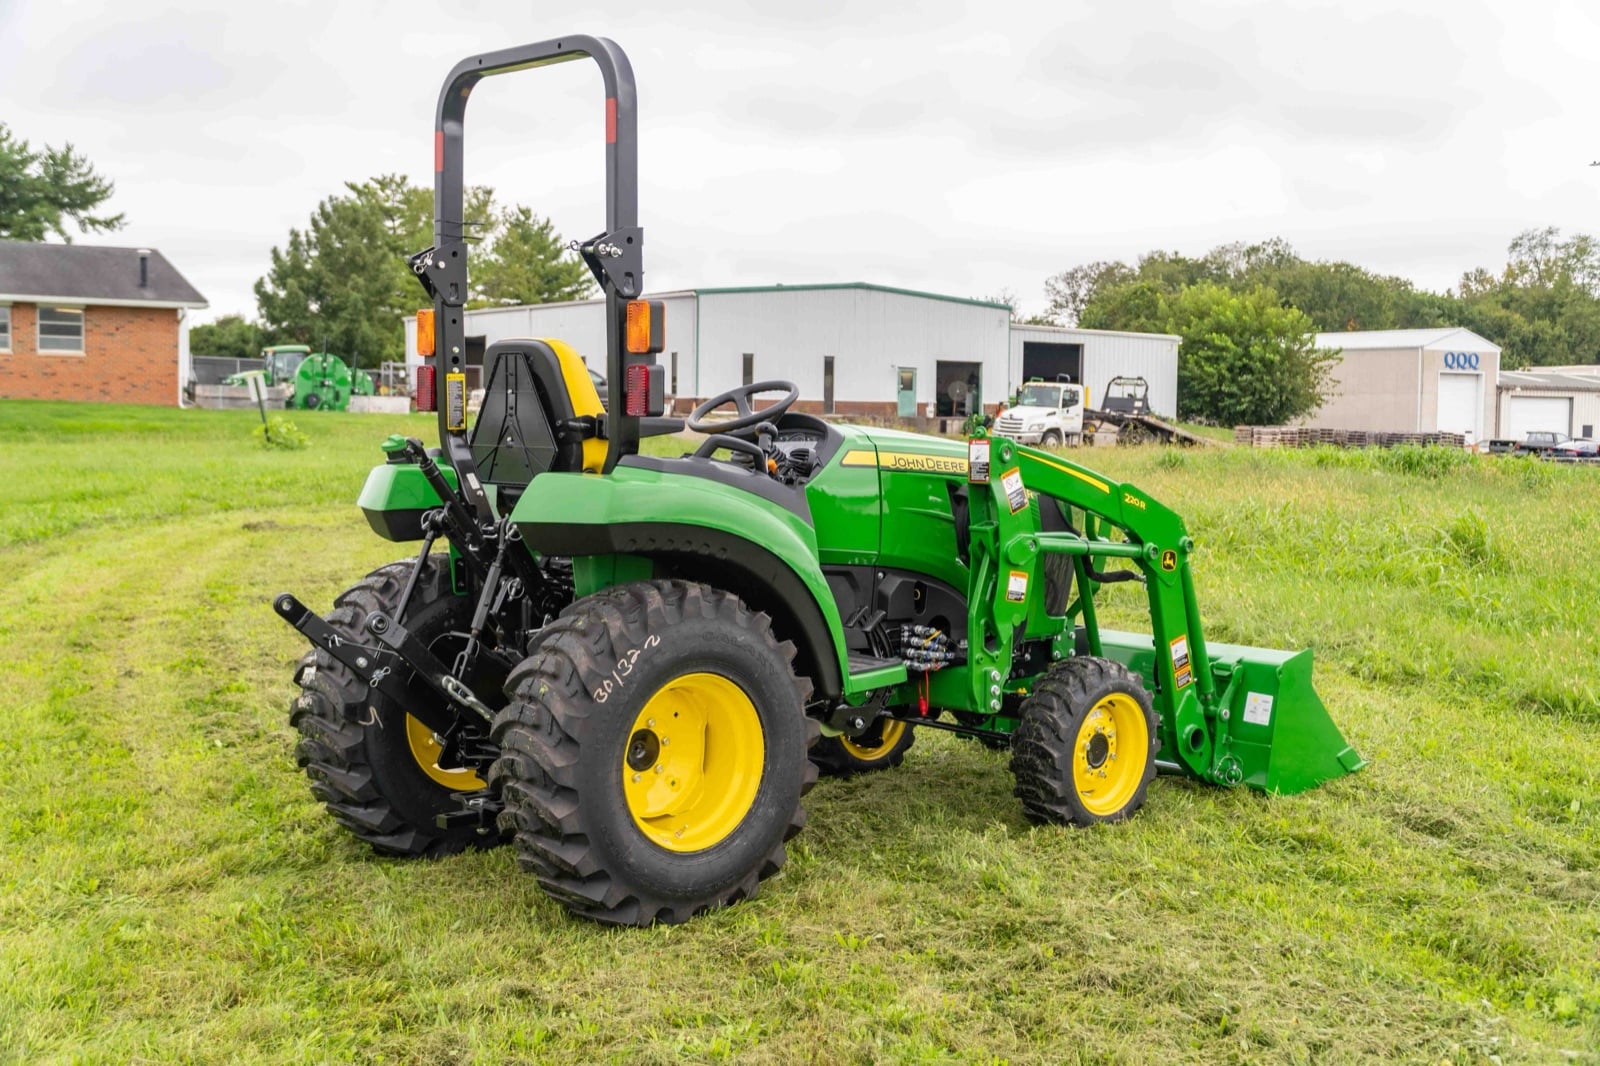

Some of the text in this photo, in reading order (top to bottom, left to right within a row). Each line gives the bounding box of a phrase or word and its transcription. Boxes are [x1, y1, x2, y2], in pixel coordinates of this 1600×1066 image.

[1444, 351, 1480, 371] QQQ
[891, 455, 925, 469] JOHN
[925, 458, 966, 472] DEERE
